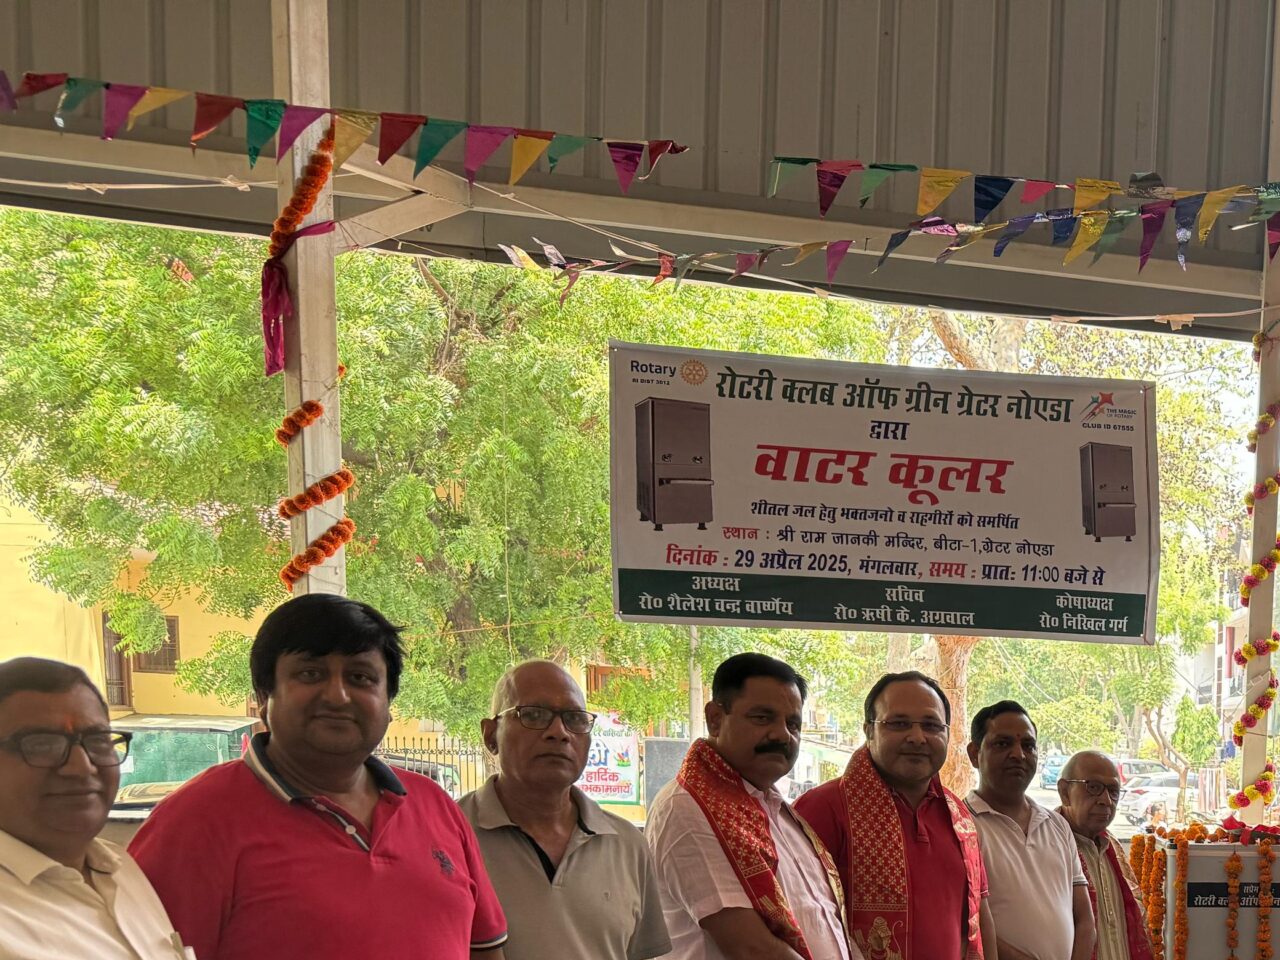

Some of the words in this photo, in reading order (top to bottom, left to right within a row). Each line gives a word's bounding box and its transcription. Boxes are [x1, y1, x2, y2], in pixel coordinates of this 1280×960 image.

[630, 360, 677, 377] Rotary
[716, 366, 777, 400] रोटरी
[782, 378, 838, 405] क्लब
[842, 377, 900, 410] ऑफ
[905, 381, 951, 414] ग्रीन
[957, 385, 1002, 417] ग्रेटर
[1006, 389, 1074, 422] नोएडा
[869, 420, 910, 441] द्वारा
[754, 444, 878, 486] वाटर
[888, 453, 1015, 506] कूलर
[751, 499, 790, 516] शीतल
[793, 504, 817, 518] जल
[819, 503, 837, 523] हेतु
[840, 506, 895, 522] भक्तजनो
[897, 511, 906, 523] व
[908, 509, 954, 527] राहगीरों
[957, 512, 974, 528] को
[976, 513, 1020, 530] समर्पित
[722, 526, 760, 540] स्थान
[776, 524, 796, 542] श्री
[800, 530, 827, 544] राम
[831, 529, 880, 546] जानकी
[1016, 539, 1055, 556] नोएडा
[665, 543, 719, 566] दिनांक
[734, 550, 754, 568] 29
[759, 548, 804, 570] अप्रैल
[929, 561, 968, 579] समय
[1021, 564, 1060, 583] 11:00
[1064, 565, 1089, 585] बजे
[1092, 566, 1106, 586] से
[692, 575, 741, 592] अध्यक्ष
[885, 585, 925, 603] सचिव
[667, 592, 711, 612] शैलेश
[714, 598, 741, 613] चन्द्र
[1056, 592, 1114, 611] कोषाध्यक्ष
[920, 610, 975, 626] अग्रवाल
[1063, 612, 1107, 631] निखिल
[1109, 616, 1129, 633] गर्ग
[586, 767, 620, 782] हार्दिक
[1193, 895, 1217, 906] रोटरी
